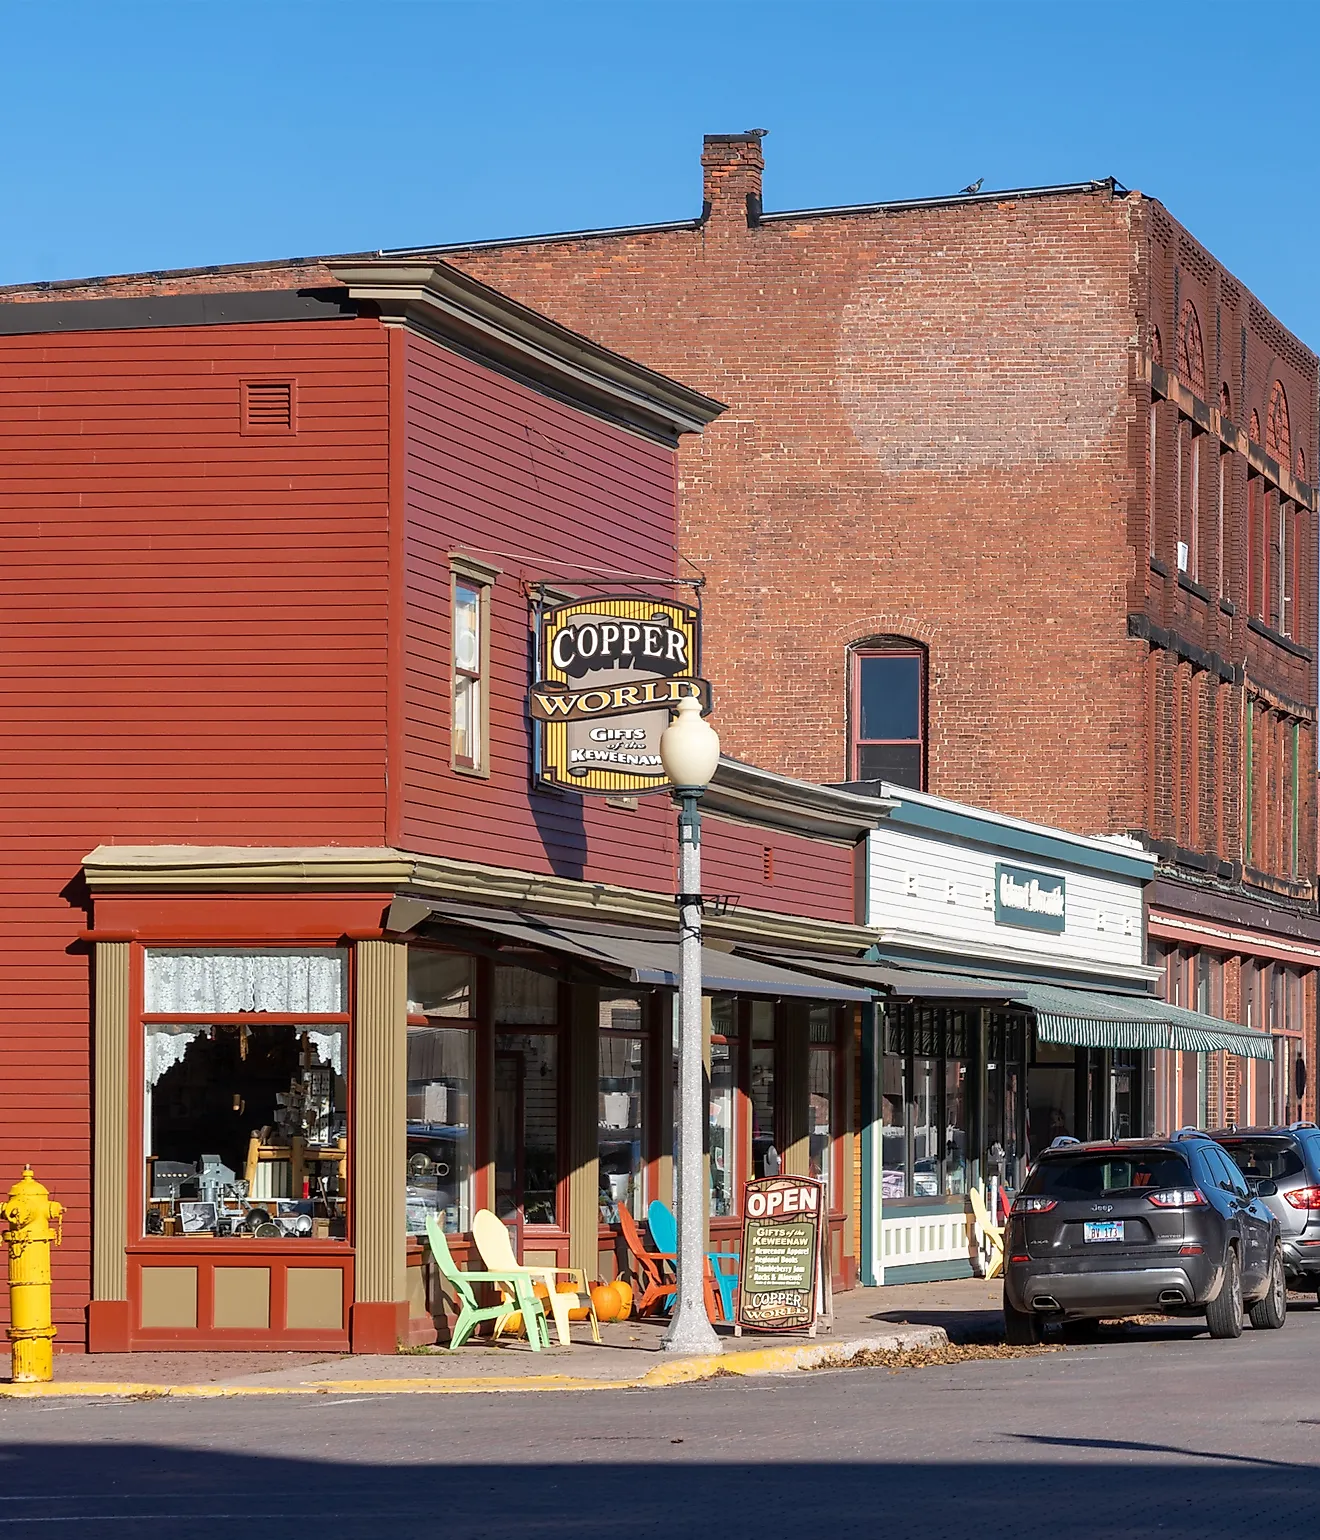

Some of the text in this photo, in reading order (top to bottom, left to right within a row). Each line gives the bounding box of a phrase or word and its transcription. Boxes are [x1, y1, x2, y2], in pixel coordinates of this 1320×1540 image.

[553, 624, 688, 669] COPPER
[533, 681, 701, 716] WORLD
[588, 727, 647, 742] GIFTS
[606, 741, 647, 751] of the
[747, 1187, 818, 1217] OPEN
[1091, 1203, 1114, 1213] Jeep
[756, 1228, 786, 1237] GIFTS
[786, 1229, 795, 1237] of
[752, 1236, 809, 1246] KEWEENAW
[752, 1292, 802, 1308] COPPER
[744, 1306, 809, 1319] WORLD
